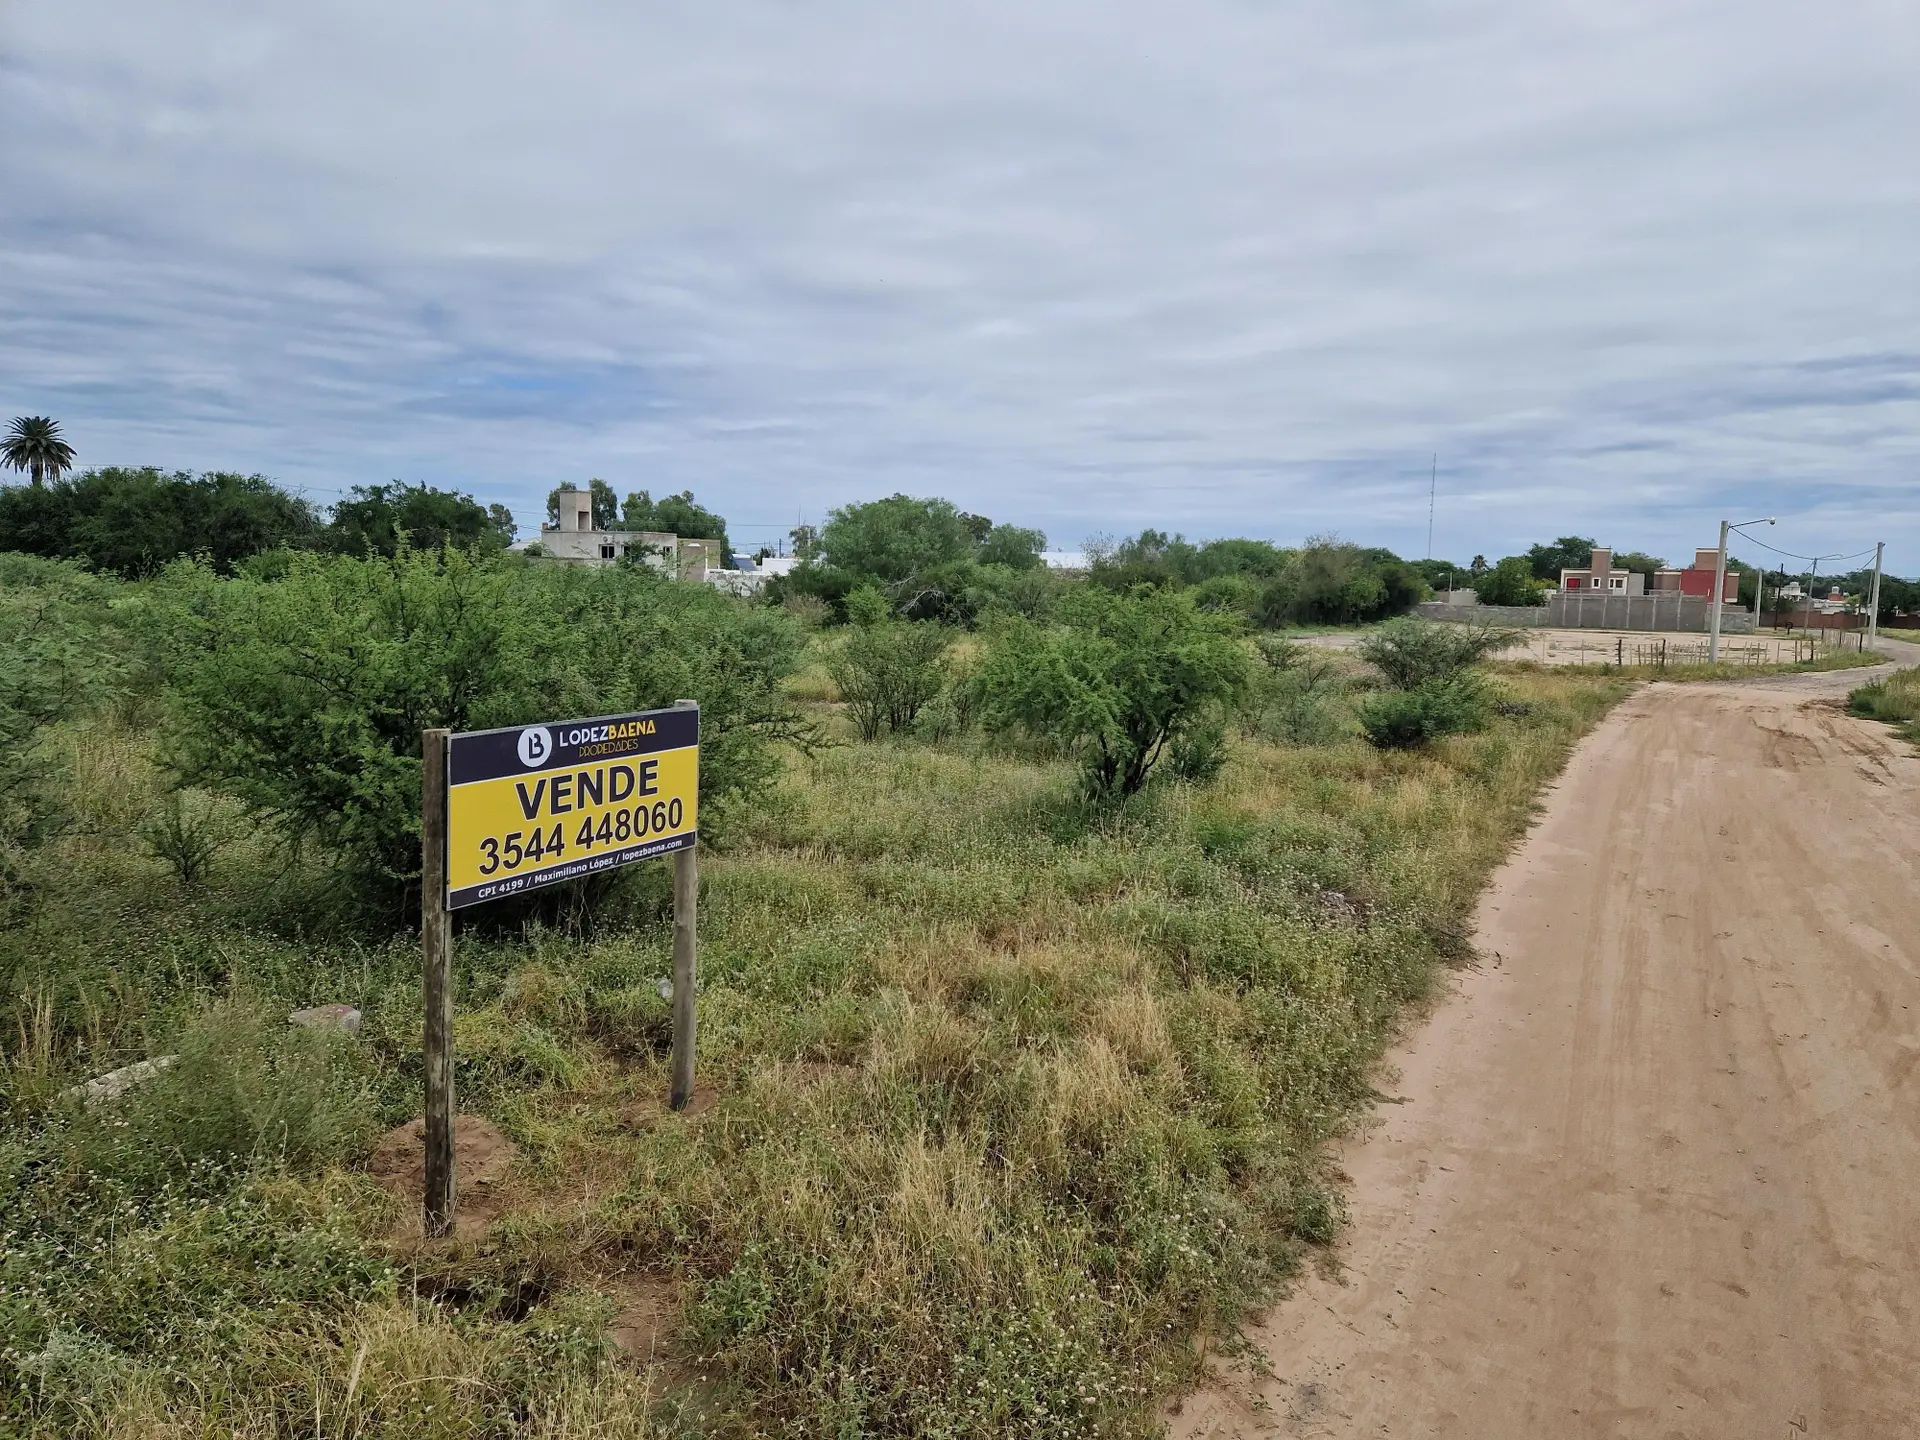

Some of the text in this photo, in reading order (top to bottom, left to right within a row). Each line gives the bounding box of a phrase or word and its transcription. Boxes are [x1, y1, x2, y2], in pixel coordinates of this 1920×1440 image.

[516, 759, 659, 820] VENDE
[480, 797, 683, 875] 3544 448060
[478, 886, 496, 899] CPI
[499, 878, 524, 893] 4199
[535, 865, 587, 884] Maximiliano
[589, 857, 613, 870] López
[622, 839, 683, 861] lopezbaena.com
